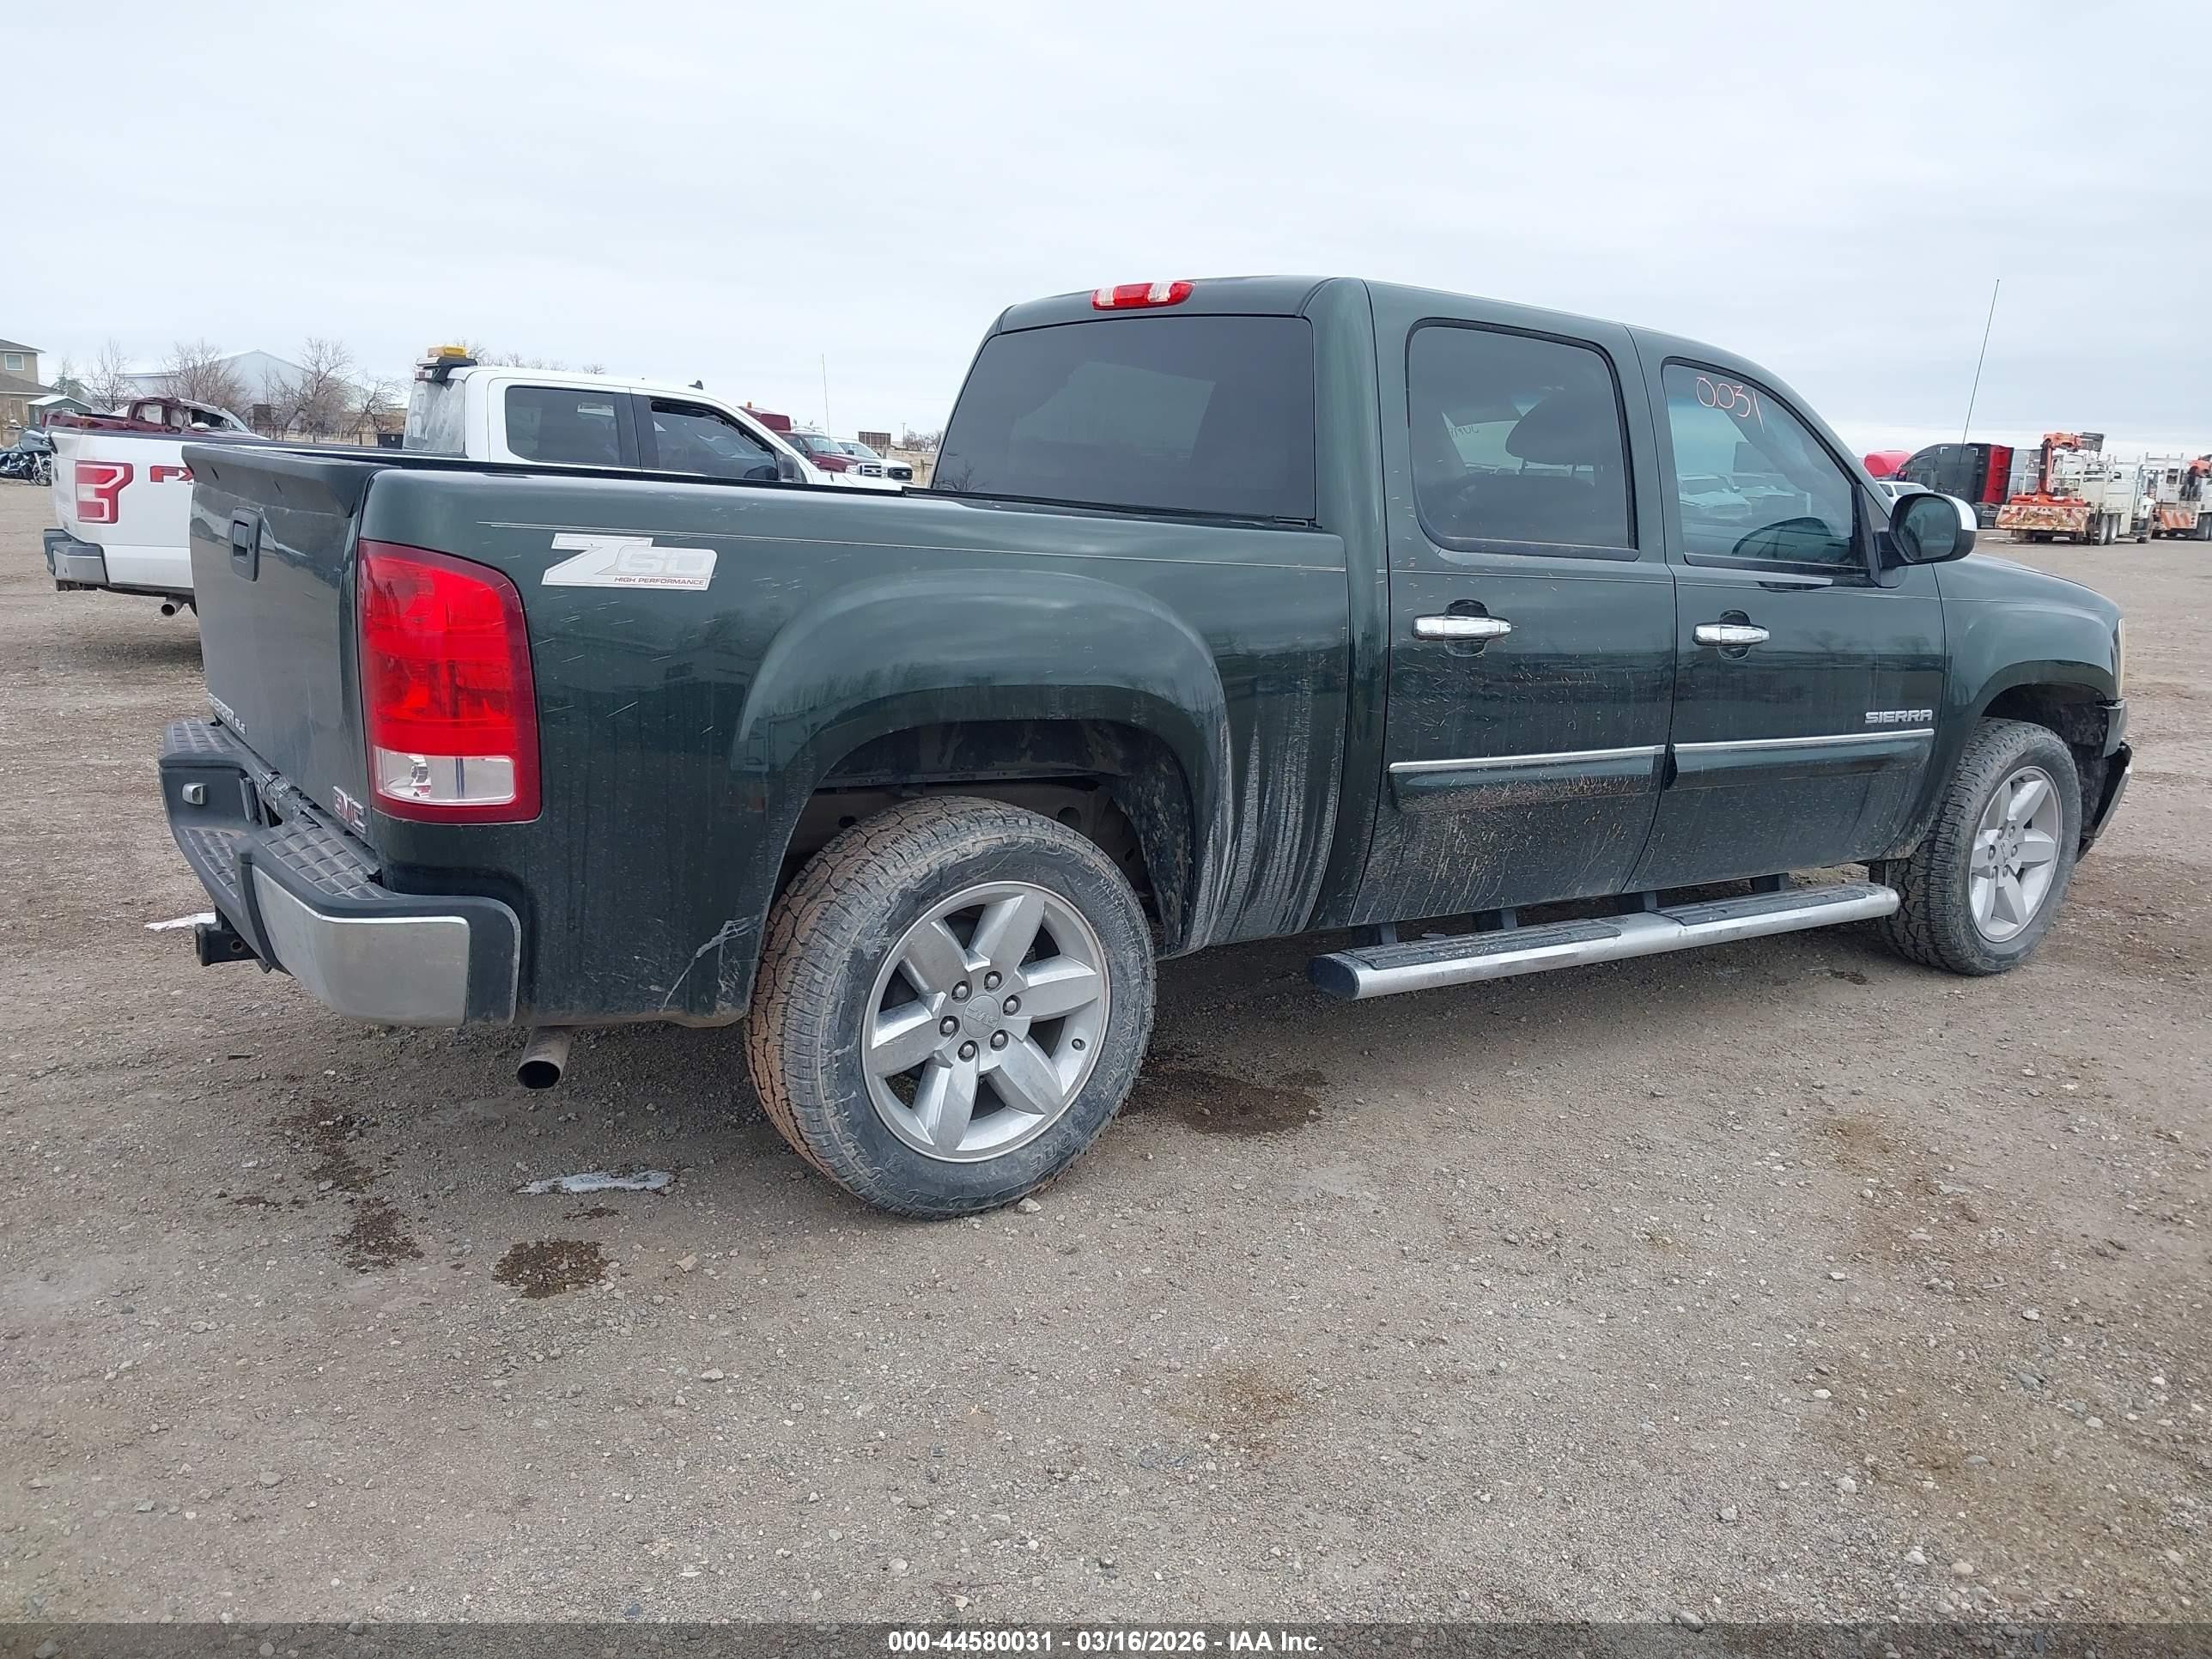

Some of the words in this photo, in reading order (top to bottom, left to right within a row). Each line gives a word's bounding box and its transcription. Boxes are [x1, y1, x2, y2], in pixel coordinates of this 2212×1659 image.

[1696, 377, 1765, 433] 0031
[542, 532, 718, 586] Z60
[1865, 709, 1933, 724] SIERRA
[332, 786, 367, 835] GMC
